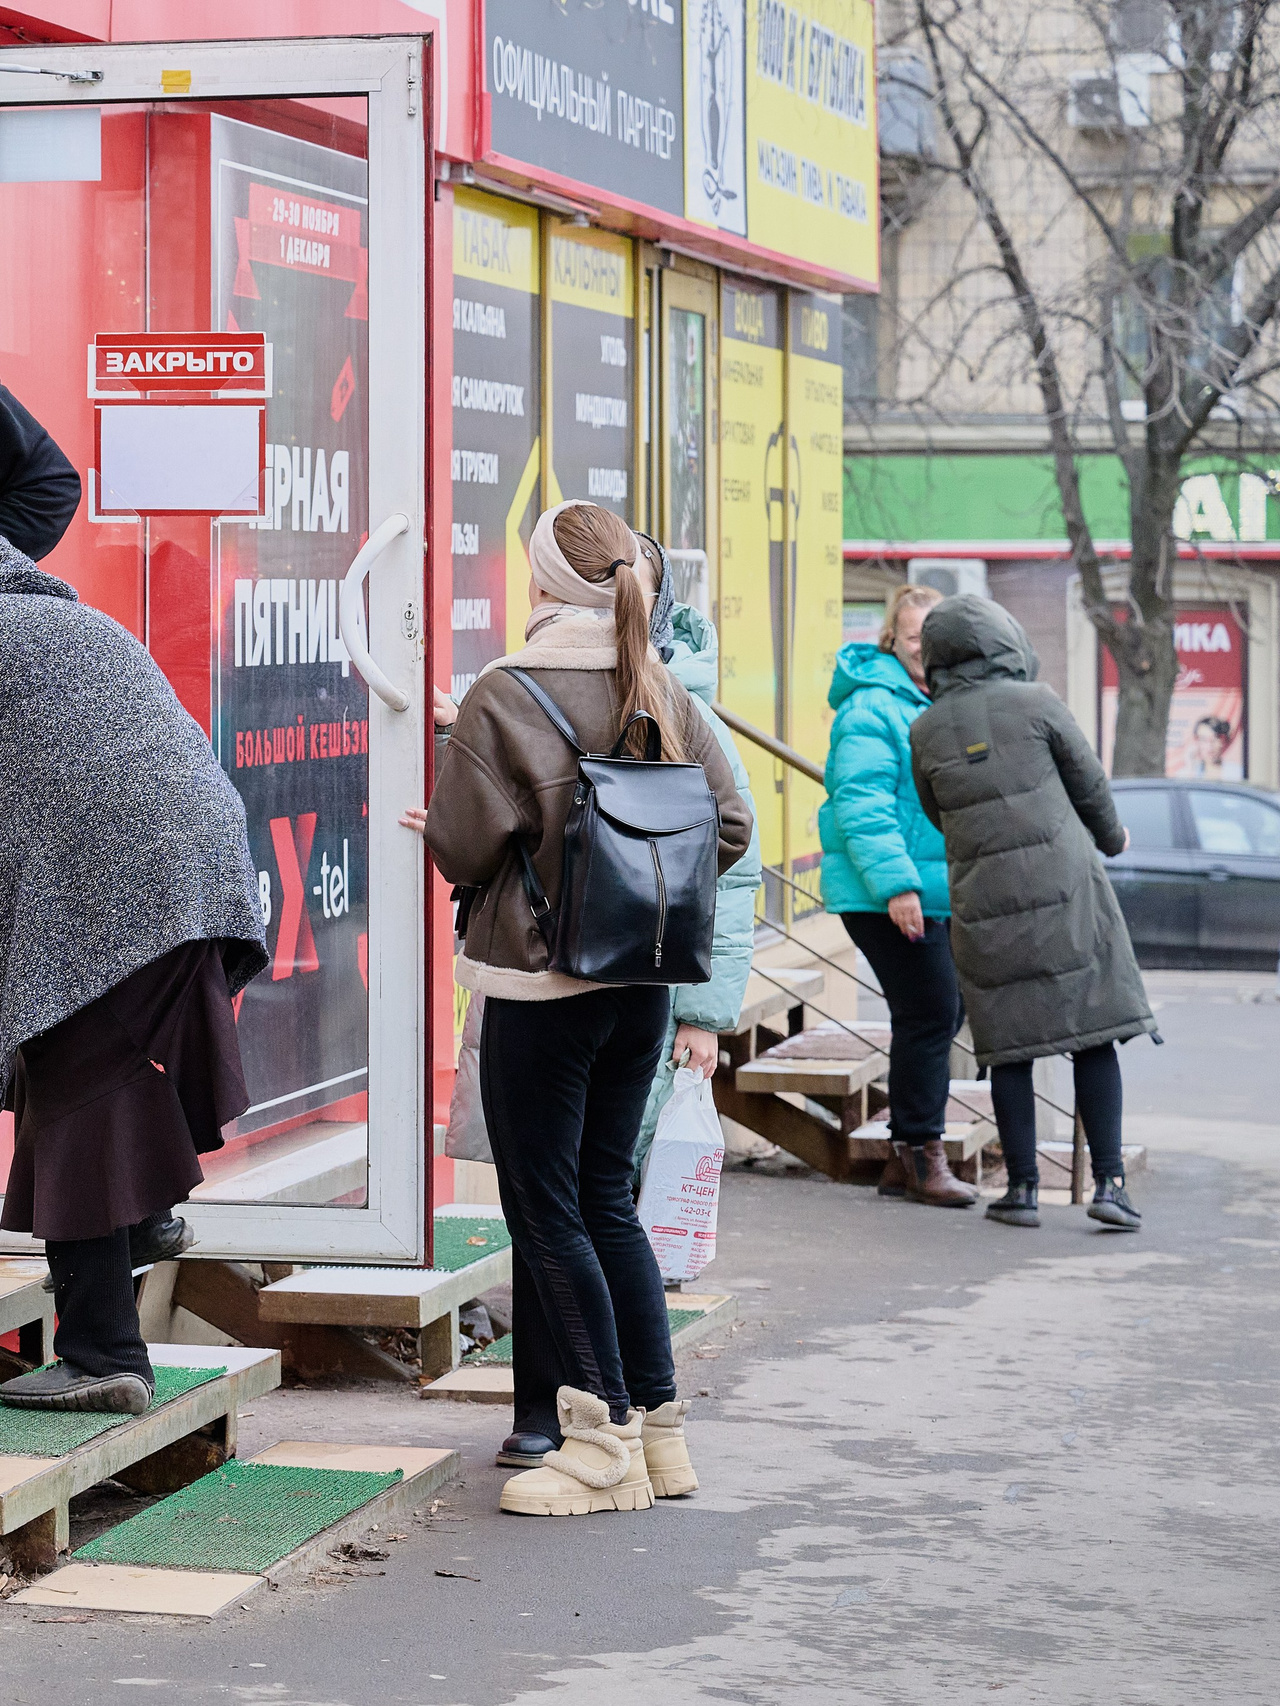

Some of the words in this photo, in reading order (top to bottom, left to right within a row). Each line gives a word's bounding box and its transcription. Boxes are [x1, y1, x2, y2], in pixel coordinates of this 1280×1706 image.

[493, 36, 612, 137] ОФИЦИАЛЬНЫЙ
[757, 137, 798, 196] МАГАЗИН
[272, 197, 300, 228] 29-30
[302, 205, 339, 237] НОЯБРЯ
[286, 238, 330, 268] ДЕКАБРЯ
[460, 211, 511, 274] ТАБАК
[553, 236, 622, 298] КАЛЬЯНЫ
[461, 300, 506, 339] КАЛЬЯНА
[106, 350, 255, 373] ЗАКРЫТО
[461, 377, 524, 416] САМОКРУТОК
[461, 451, 498, 484] ТРУБКИ
[451, 523, 479, 555] ЛЬЗЫ
[234, 578, 368, 677] ПЯТНИЦ
[451, 598, 491, 630] ШИНКИ
[236, 714, 305, 769] БОЛЬШОЙ
[309, 719, 369, 759] КЕШБЭК
[269, 812, 349, 981] X-tel
[681, 1183, 717, 1197] КТ-ЦЕН
